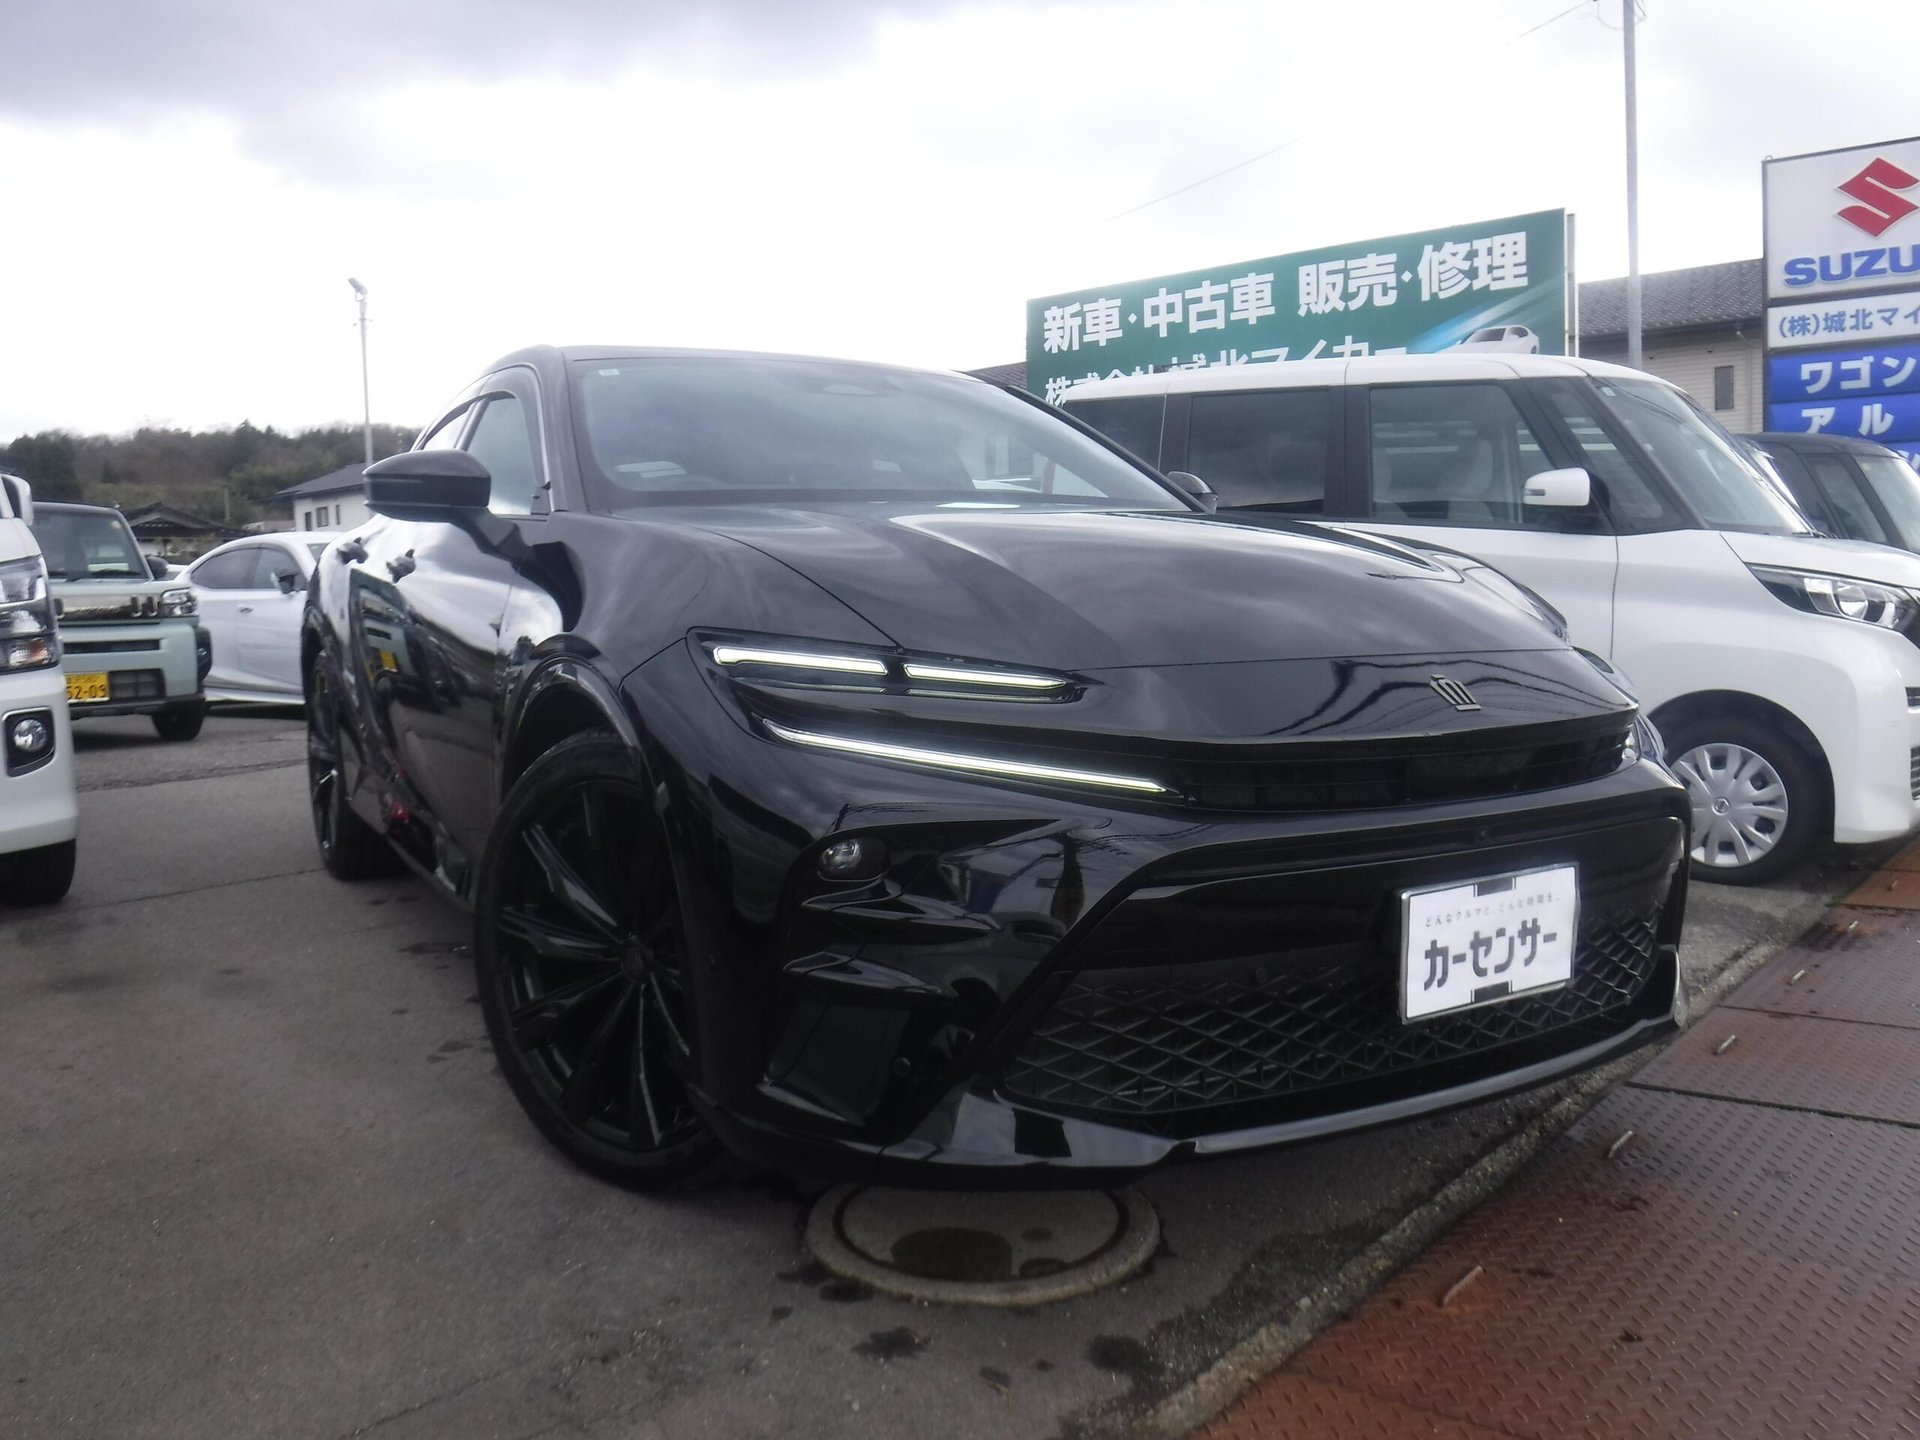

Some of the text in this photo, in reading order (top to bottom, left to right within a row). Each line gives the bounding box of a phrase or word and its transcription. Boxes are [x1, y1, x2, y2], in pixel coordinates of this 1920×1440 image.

[1423, 918, 1557, 991] カーセンサー
